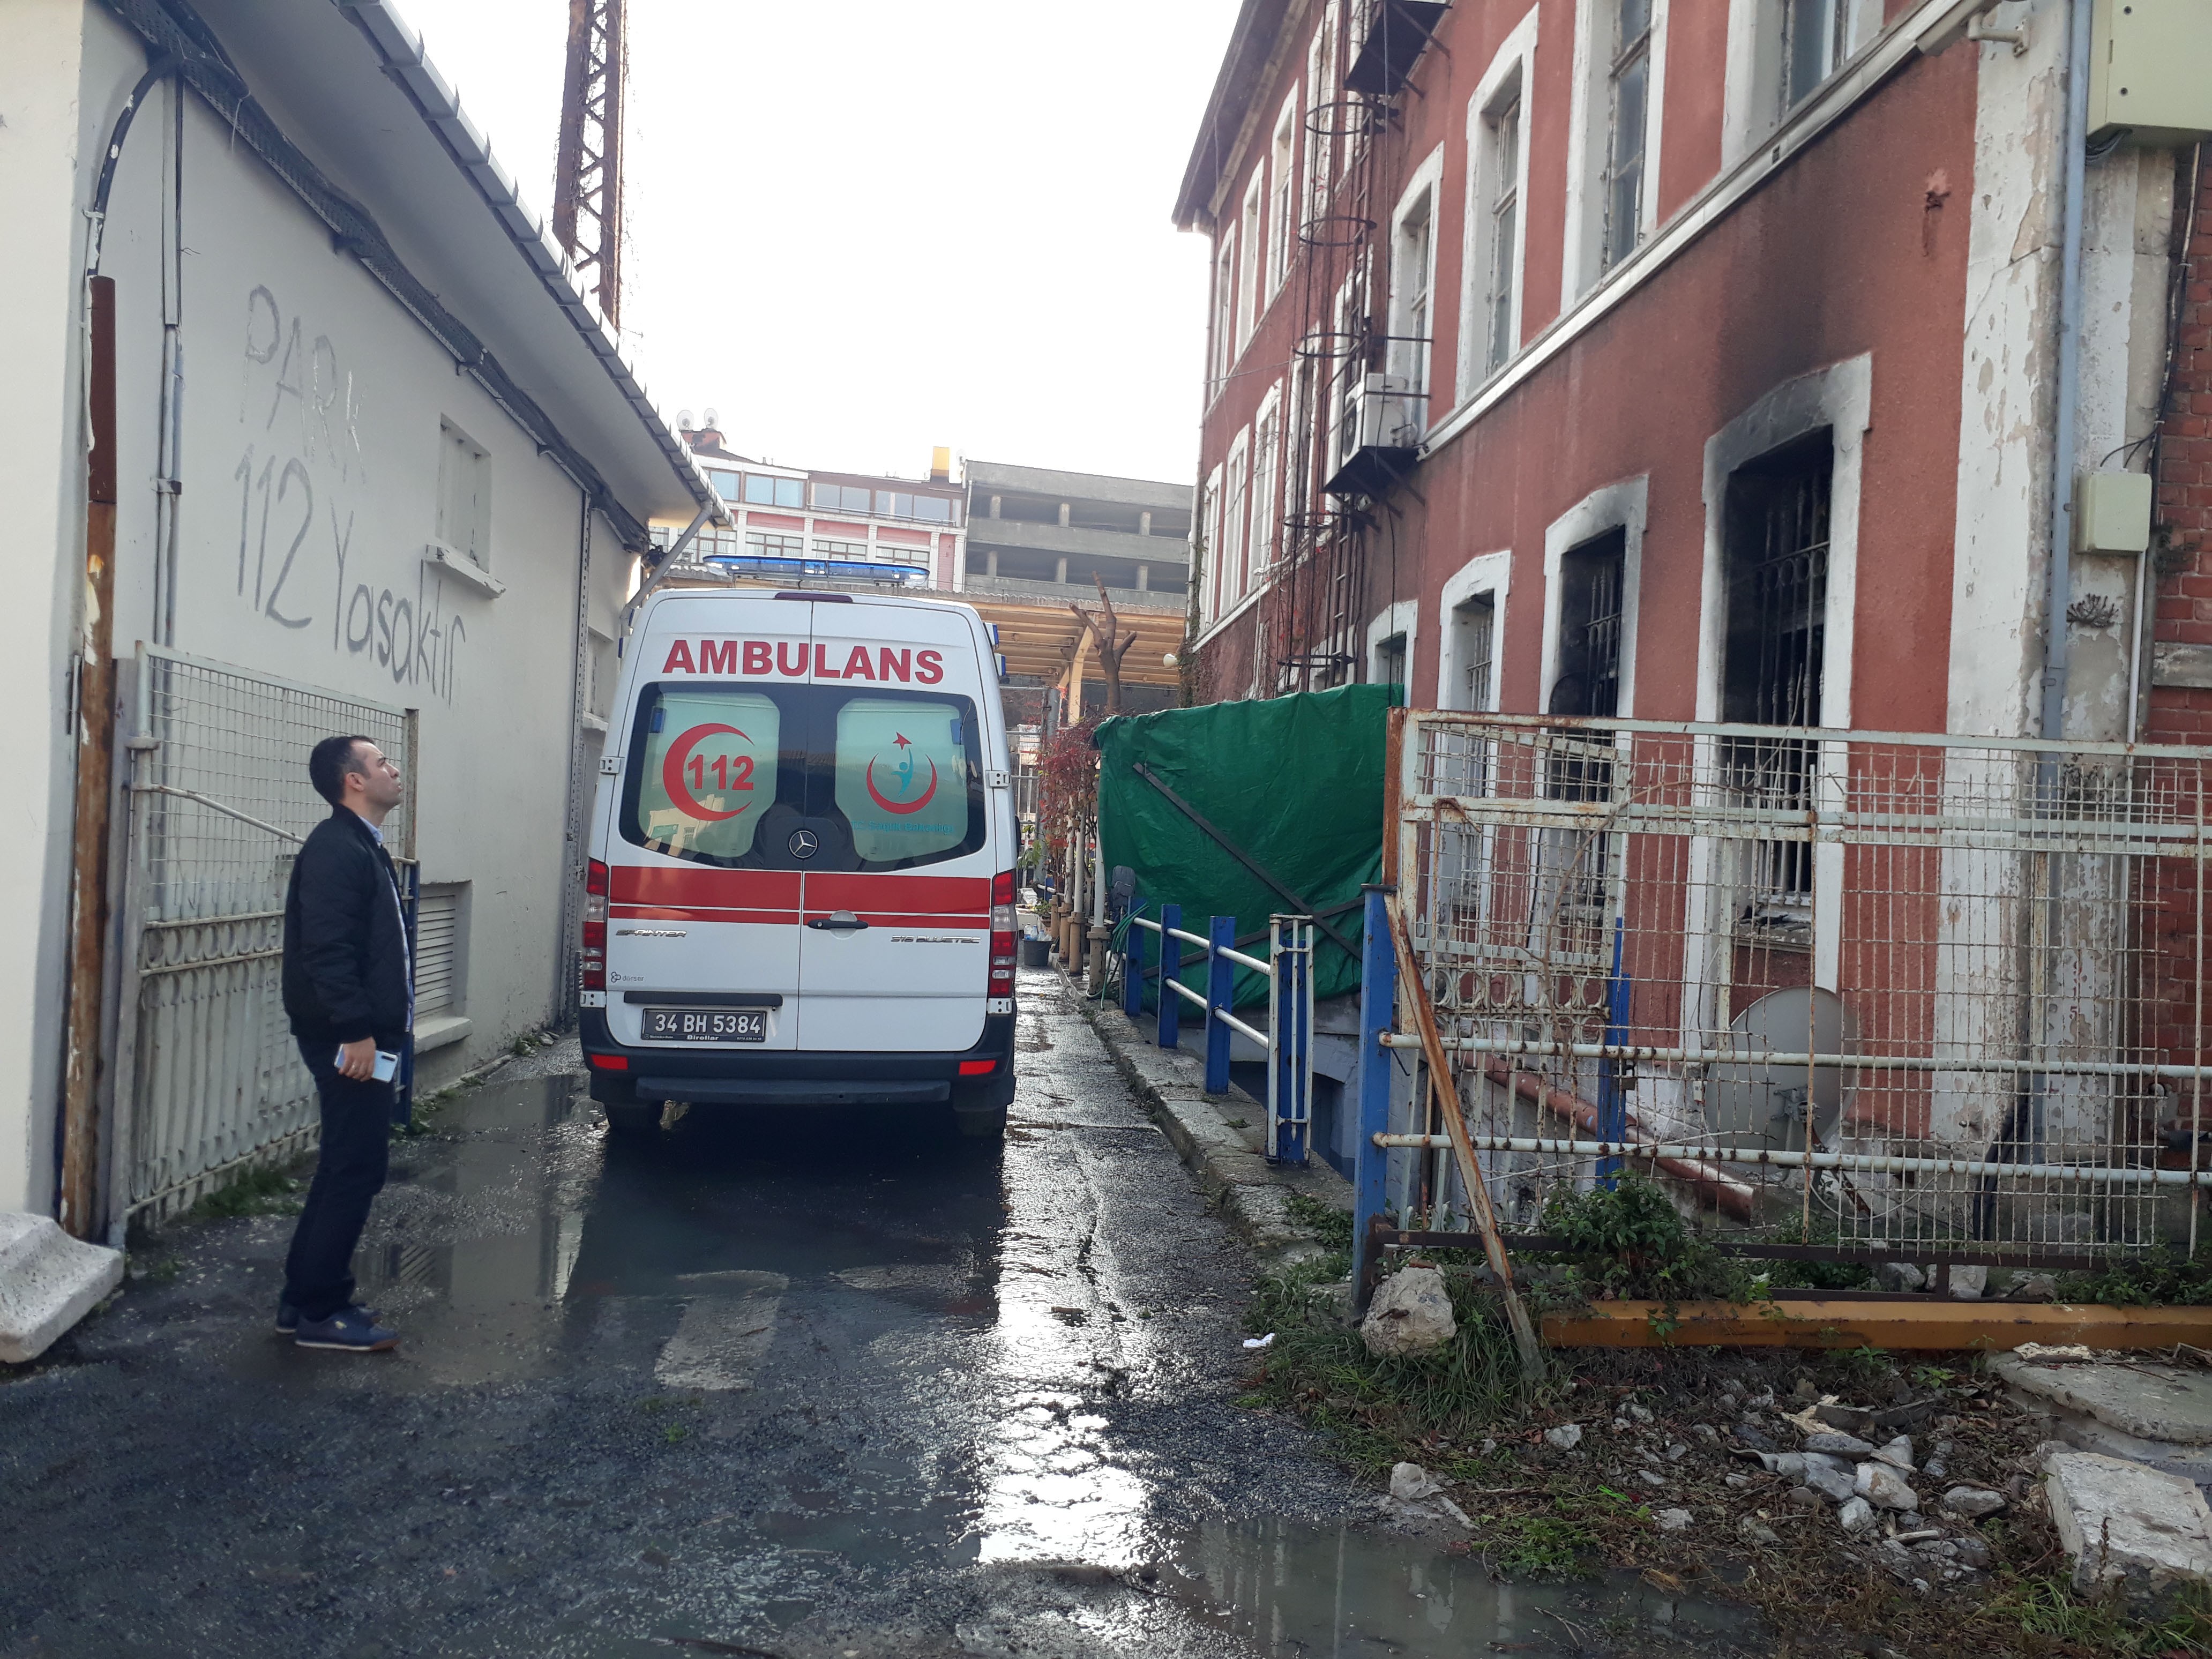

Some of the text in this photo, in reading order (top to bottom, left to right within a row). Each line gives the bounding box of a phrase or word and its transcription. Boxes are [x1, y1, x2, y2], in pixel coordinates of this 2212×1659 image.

[240, 284, 368, 484] PARK
[235, 444, 312, 629] 112
[662, 640, 944, 684] AMBULANS
[687, 754, 754, 790] 112
[616, 930, 687, 938] SPRINTER
[655, 1014, 760, 1034] 34 BH 5384
